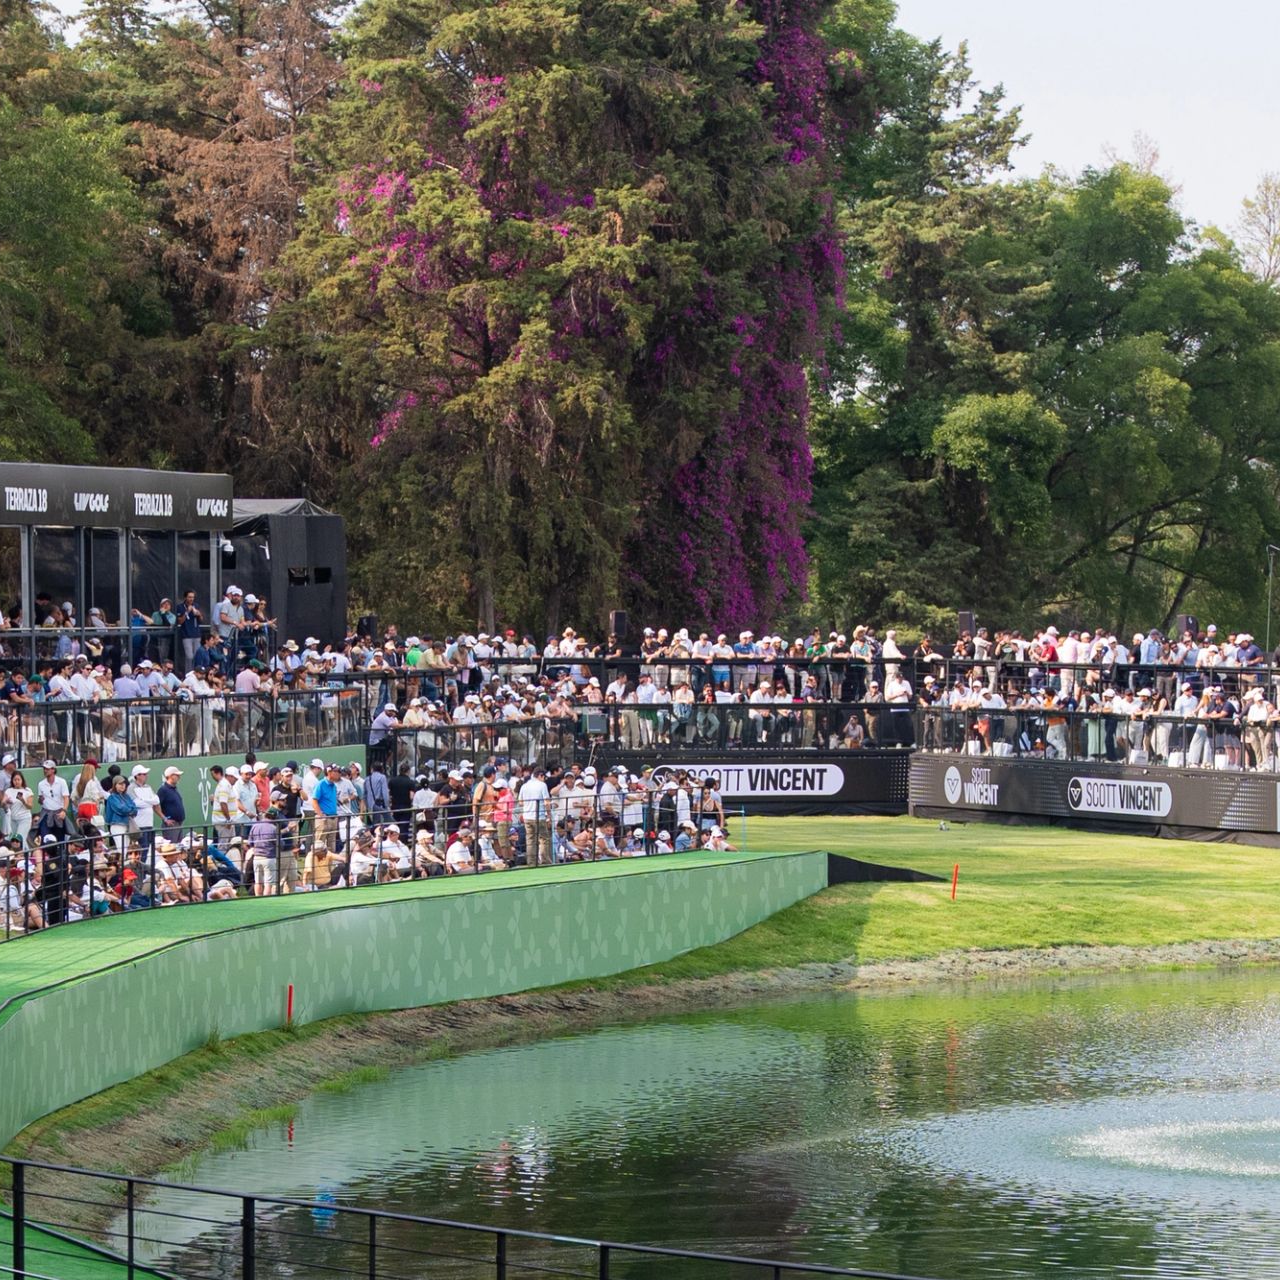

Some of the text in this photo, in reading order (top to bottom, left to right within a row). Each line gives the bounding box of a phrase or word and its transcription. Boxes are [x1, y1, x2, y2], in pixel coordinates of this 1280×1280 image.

[5, 487, 47, 512] TERRAZA 18
[134, 493, 172, 516] TERRAZA 18
[747, 768, 827, 791] VINCENT
[971, 768, 991, 784] SCOTT
[964, 782, 999, 806] VINCENT
[1086, 781, 1162, 812] SCOTT VINCENT
